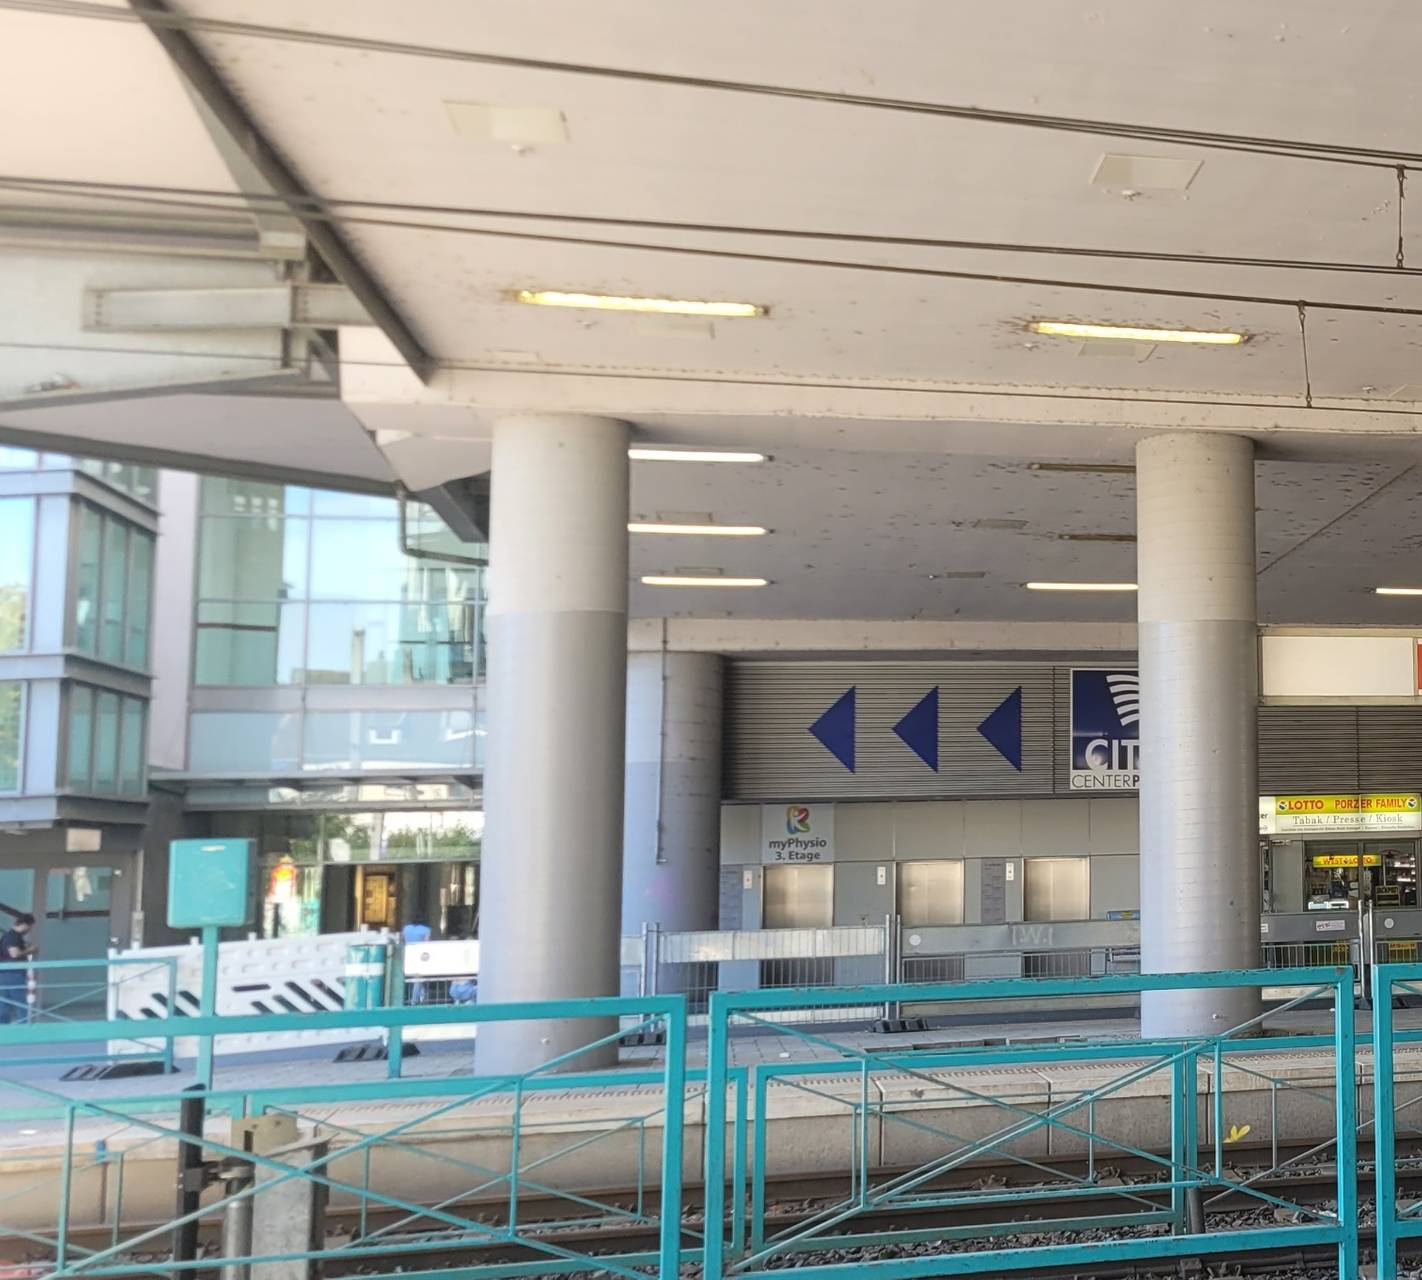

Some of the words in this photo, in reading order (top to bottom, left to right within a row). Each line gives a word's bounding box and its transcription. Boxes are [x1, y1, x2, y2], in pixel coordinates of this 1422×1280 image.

[1085, 739, 1139, 770] CIT
[1072, 774, 1139, 788] CENTERP
[1288, 800, 1324, 810] LOTTO
[1335, 799, 1372, 809] PORZER
[1376, 798, 1407, 808] FAMILY
[1293, 815, 1323, 825] Tabak
[1333, 815, 1365, 824] Presse
[1376, 813, 1403, 823] Kiosk
[769, 838, 827, 851] myPhysio
[776, 851, 786, 860] 3.
[788, 851, 821, 861] Etage
